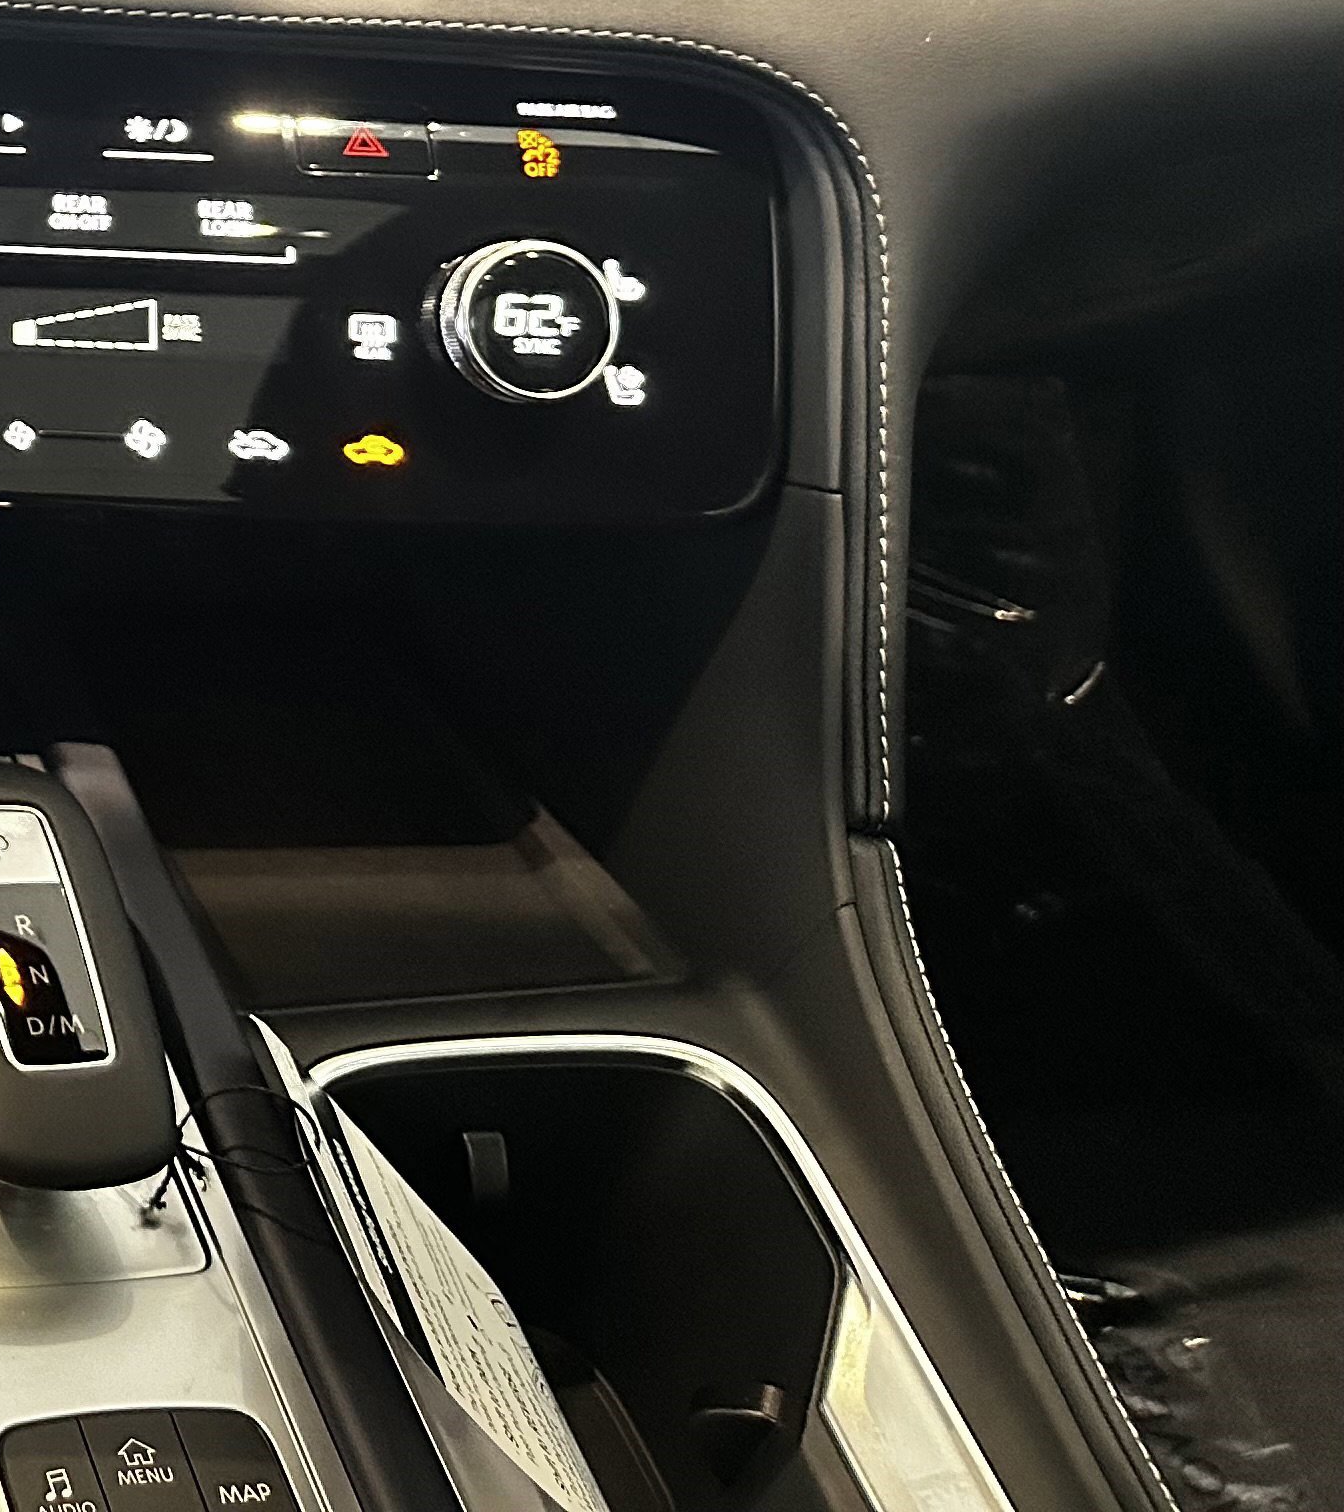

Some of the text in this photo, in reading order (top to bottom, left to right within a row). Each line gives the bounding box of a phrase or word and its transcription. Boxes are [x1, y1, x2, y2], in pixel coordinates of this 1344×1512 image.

[14, 914, 35, 937] R
[28, 964, 51, 986] N
[26, 1014, 86, 1037] D/M
[117, 1466, 174, 1486] MENU
[218, 1482, 272, 1505] MAP
